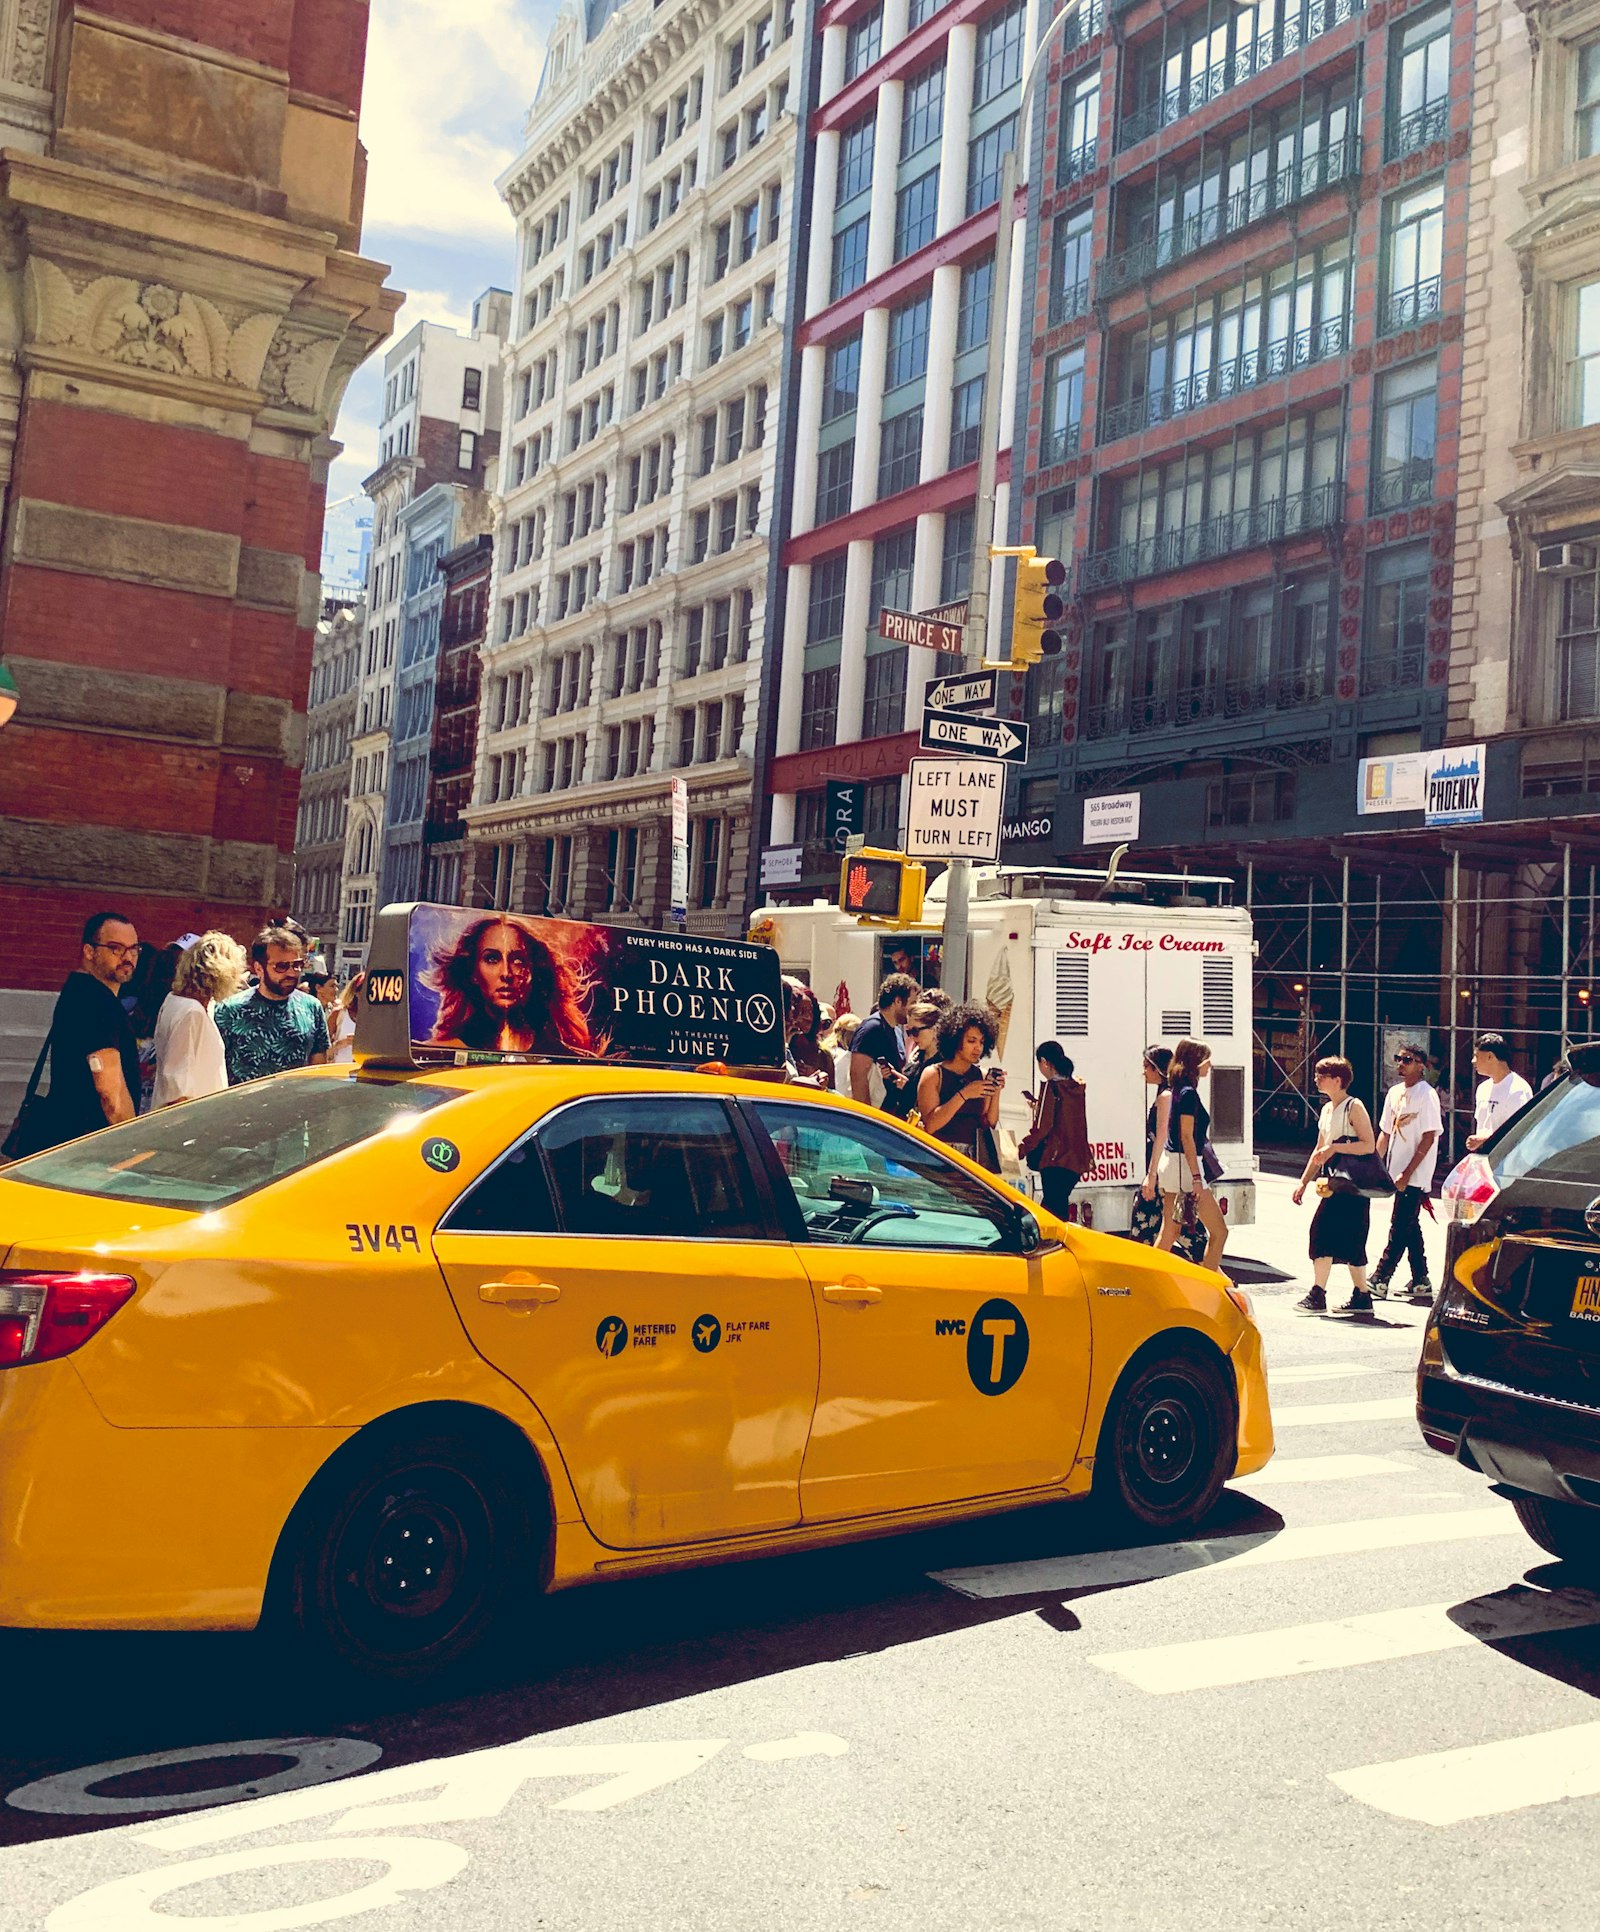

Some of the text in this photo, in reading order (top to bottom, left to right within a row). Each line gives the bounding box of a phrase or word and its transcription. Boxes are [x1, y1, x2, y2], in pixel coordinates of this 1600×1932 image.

[885, 614, 958, 652] PRINCE ST
[934, 682, 987, 706] ONE WAY
[938, 723, 968, 742] ONE
[982, 729, 1012, 748] WAY
[918, 771, 996, 789] LEFT LANE
[1101, 800, 1133, 811] Broadway
[1429, 777, 1480, 813] PHOENIX
[930, 799, 980, 818] MUST
[914, 829, 992, 847] TURN LEFT
[1002, 818, 1051, 840] MANGO
[627, 936, 758, 960] EVERY HERO HAS A DARK SIDE
[1066, 931, 1225, 954] Soft Ice Cream
[649, 959, 735, 992] DARK
[368, 975, 403, 1002] 3V49
[613, 986, 772, 1027] PHOENIX
[685, 1031, 729, 1041] THEATERS
[667, 1039, 715, 1056] JUNE
[722, 1043, 730, 1057] 7
[346, 1223, 421, 1254] 3V49
[726, 1321, 770, 1331] FLAT FARE
[1444, 1307, 1490, 1325] ROGUE
[633, 1323, 676, 1335] METERED
[725, 1334, 742, 1343] JFK
[633, 1336, 657, 1347] FARE
[935, 1318, 1016, 1384] NYC T
